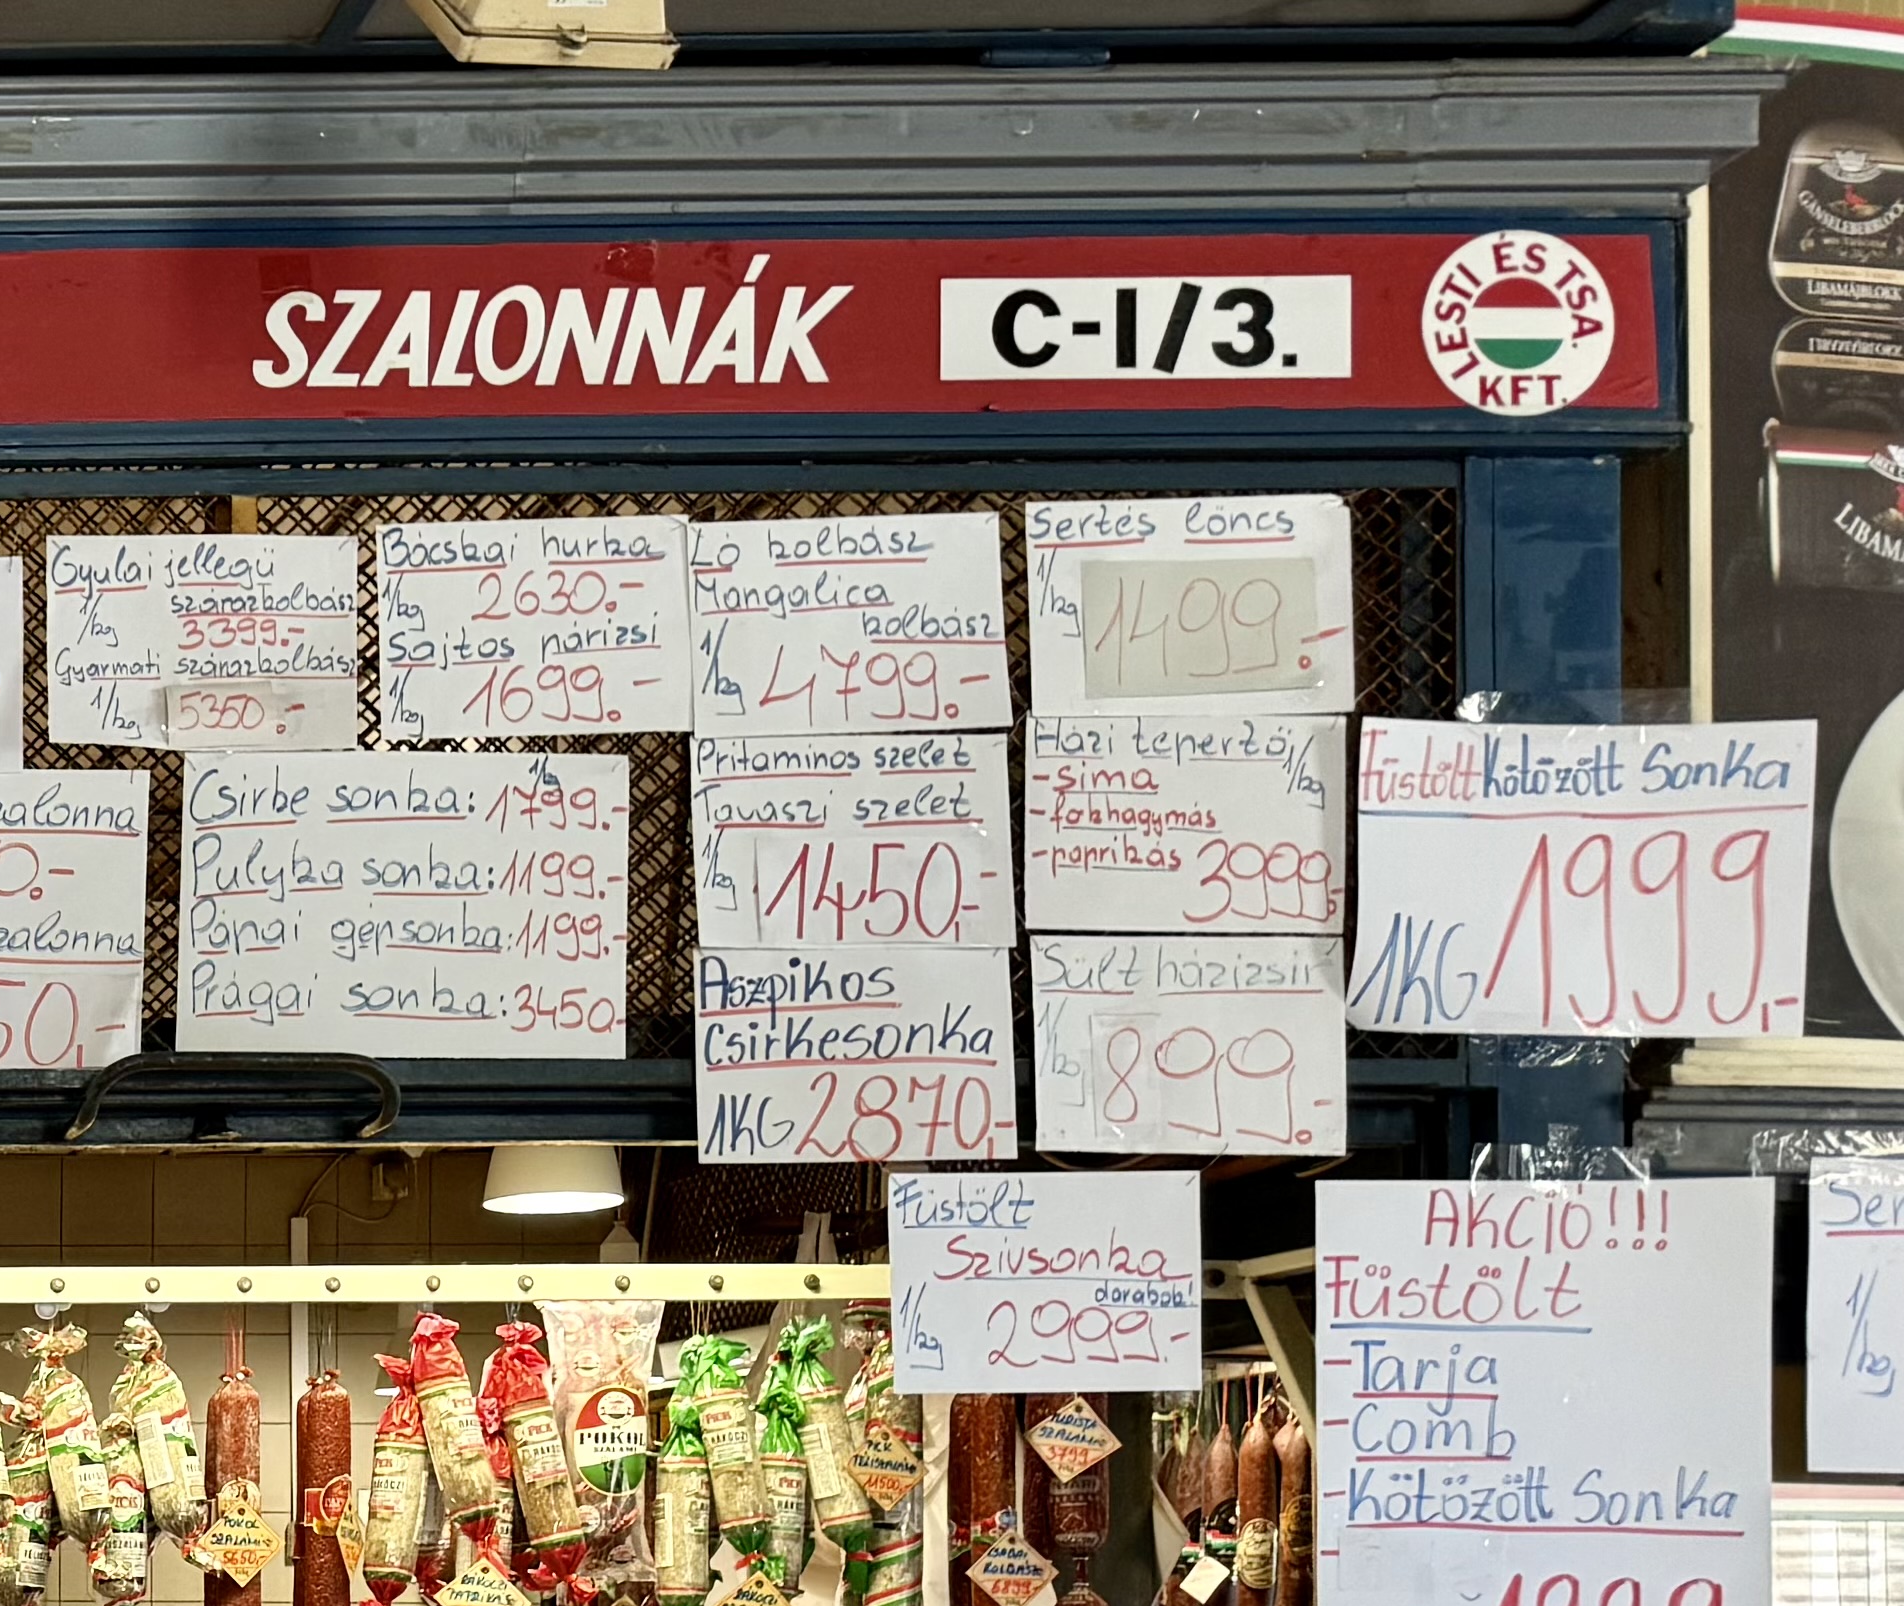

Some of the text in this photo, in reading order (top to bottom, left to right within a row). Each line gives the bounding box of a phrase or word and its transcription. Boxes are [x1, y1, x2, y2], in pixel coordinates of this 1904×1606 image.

[253, 254, 858, 389] SZALONNÁK
[1435, 263, 1482, 380] LESTI
[1493, 233, 1547, 274] ÉS
[1479, 374, 1567, 407] KFT.
[1029, 506, 1156, 540] Sertés
[693, 573, 889, 614] Mangalica
[389, 631, 514, 669] Sajtos
[879, 737, 971, 770] szelet
[693, 782, 972, 825] Tavaszi szelet
[1350, 828, 1800, 1033] 1KG 1999,-
[894, 1178, 1035, 1227] Füstölt
[1323, 1255, 1583, 1321] Füstölt
[1351, 1338, 1498, 1418] Tarja
[576, 1428, 645, 1445] POKOL
[1353, 1396, 1517, 1458] Comb
